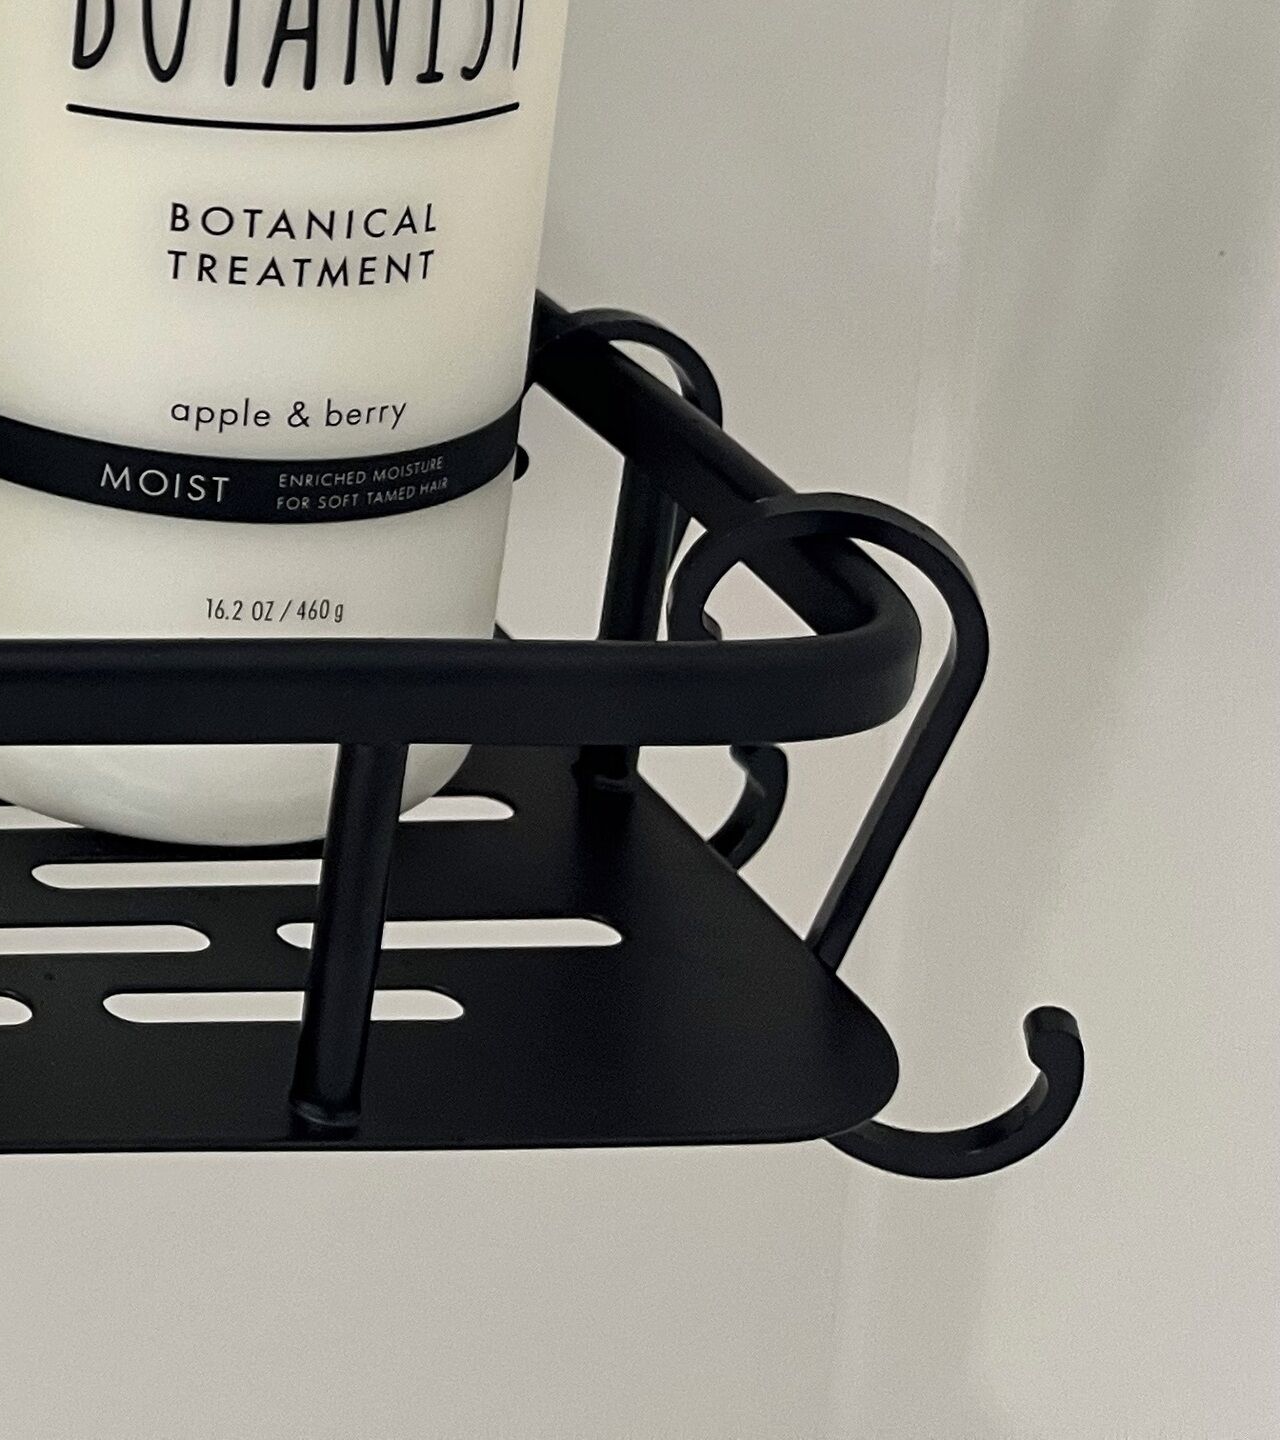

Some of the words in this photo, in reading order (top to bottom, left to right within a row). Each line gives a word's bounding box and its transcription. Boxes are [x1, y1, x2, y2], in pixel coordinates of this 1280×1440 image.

[170, 202, 437, 241] BOTANICAL
[167, 249, 435, 288] TREATMENT
[170, 397, 271, 434] apple
[287, 400, 310, 428] &
[325, 398, 407, 430] berry
[100, 463, 230, 503] MOIST
[278, 470, 367, 488] ENRICHED
[372, 455, 443, 482] MOISTURE
[276, 496, 310, 511] FOR
[317, 493, 359, 510] SOFT
[367, 485, 416, 505] TAMED
[419, 476, 449, 495] HAIR
[206, 598, 244, 621] 16.2
[251, 600, 275, 622] OZ
[296, 599, 330, 621] 460
[334, 603, 344, 624] g
